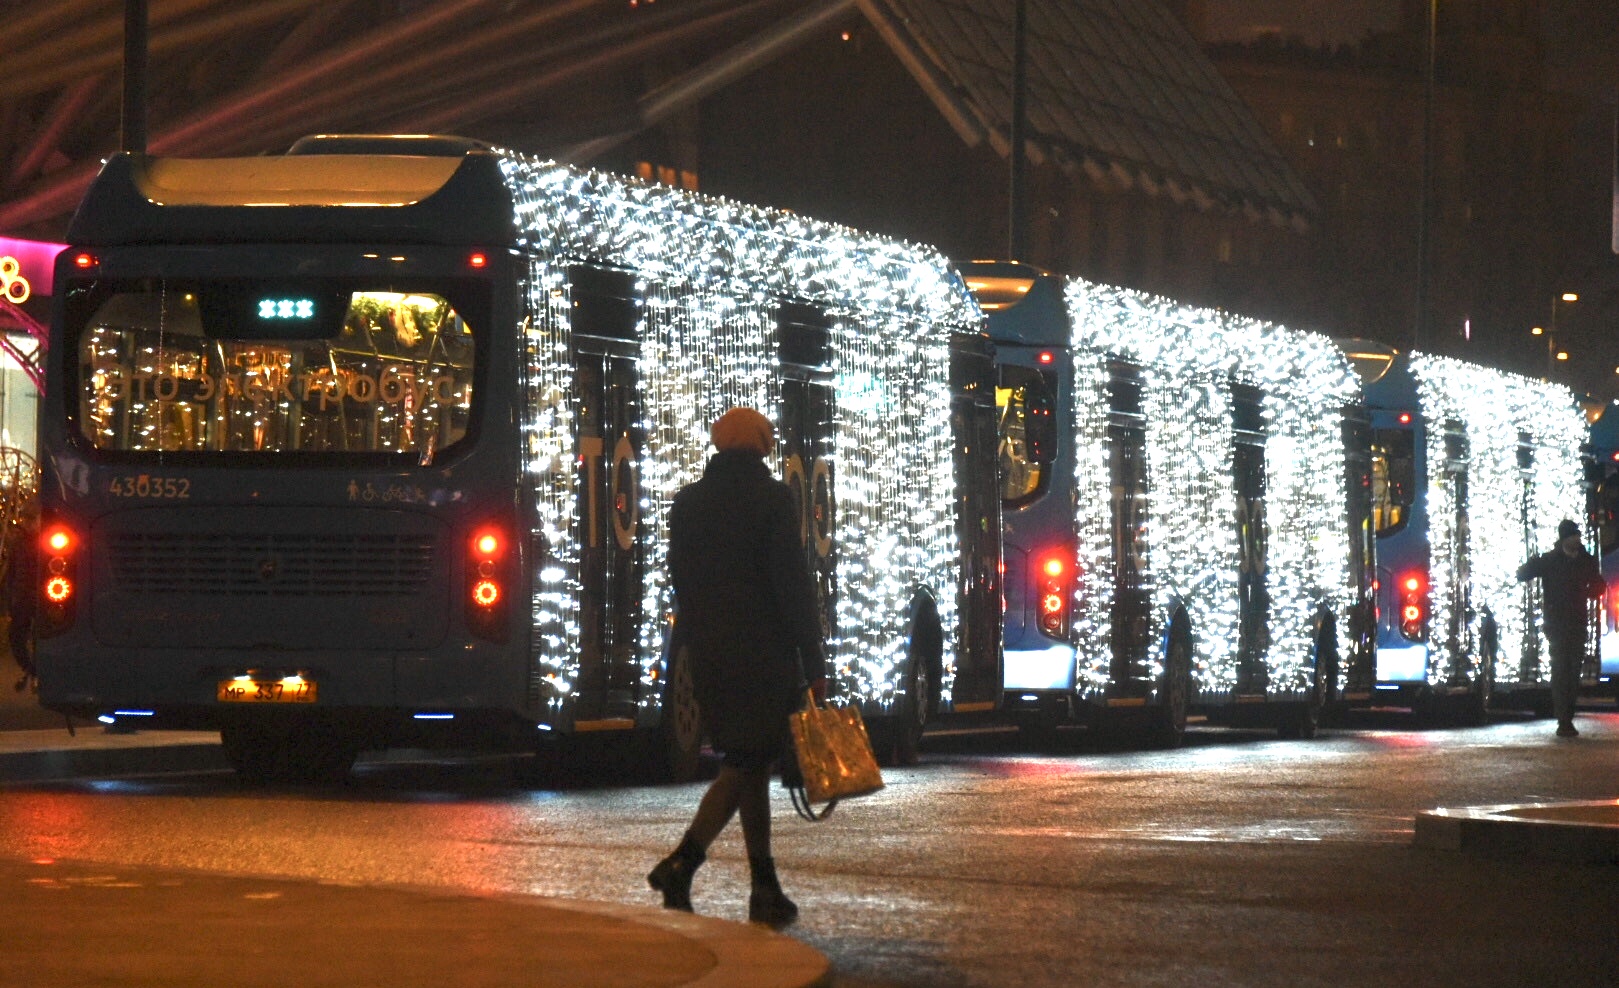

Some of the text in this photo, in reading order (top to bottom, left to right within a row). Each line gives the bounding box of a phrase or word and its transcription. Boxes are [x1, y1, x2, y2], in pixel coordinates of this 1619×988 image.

[193, 364, 455, 413] электробус
[109, 476, 190, 498] 430352
[254, 683, 283, 700] 337
[296, 683, 312, 696] 77
